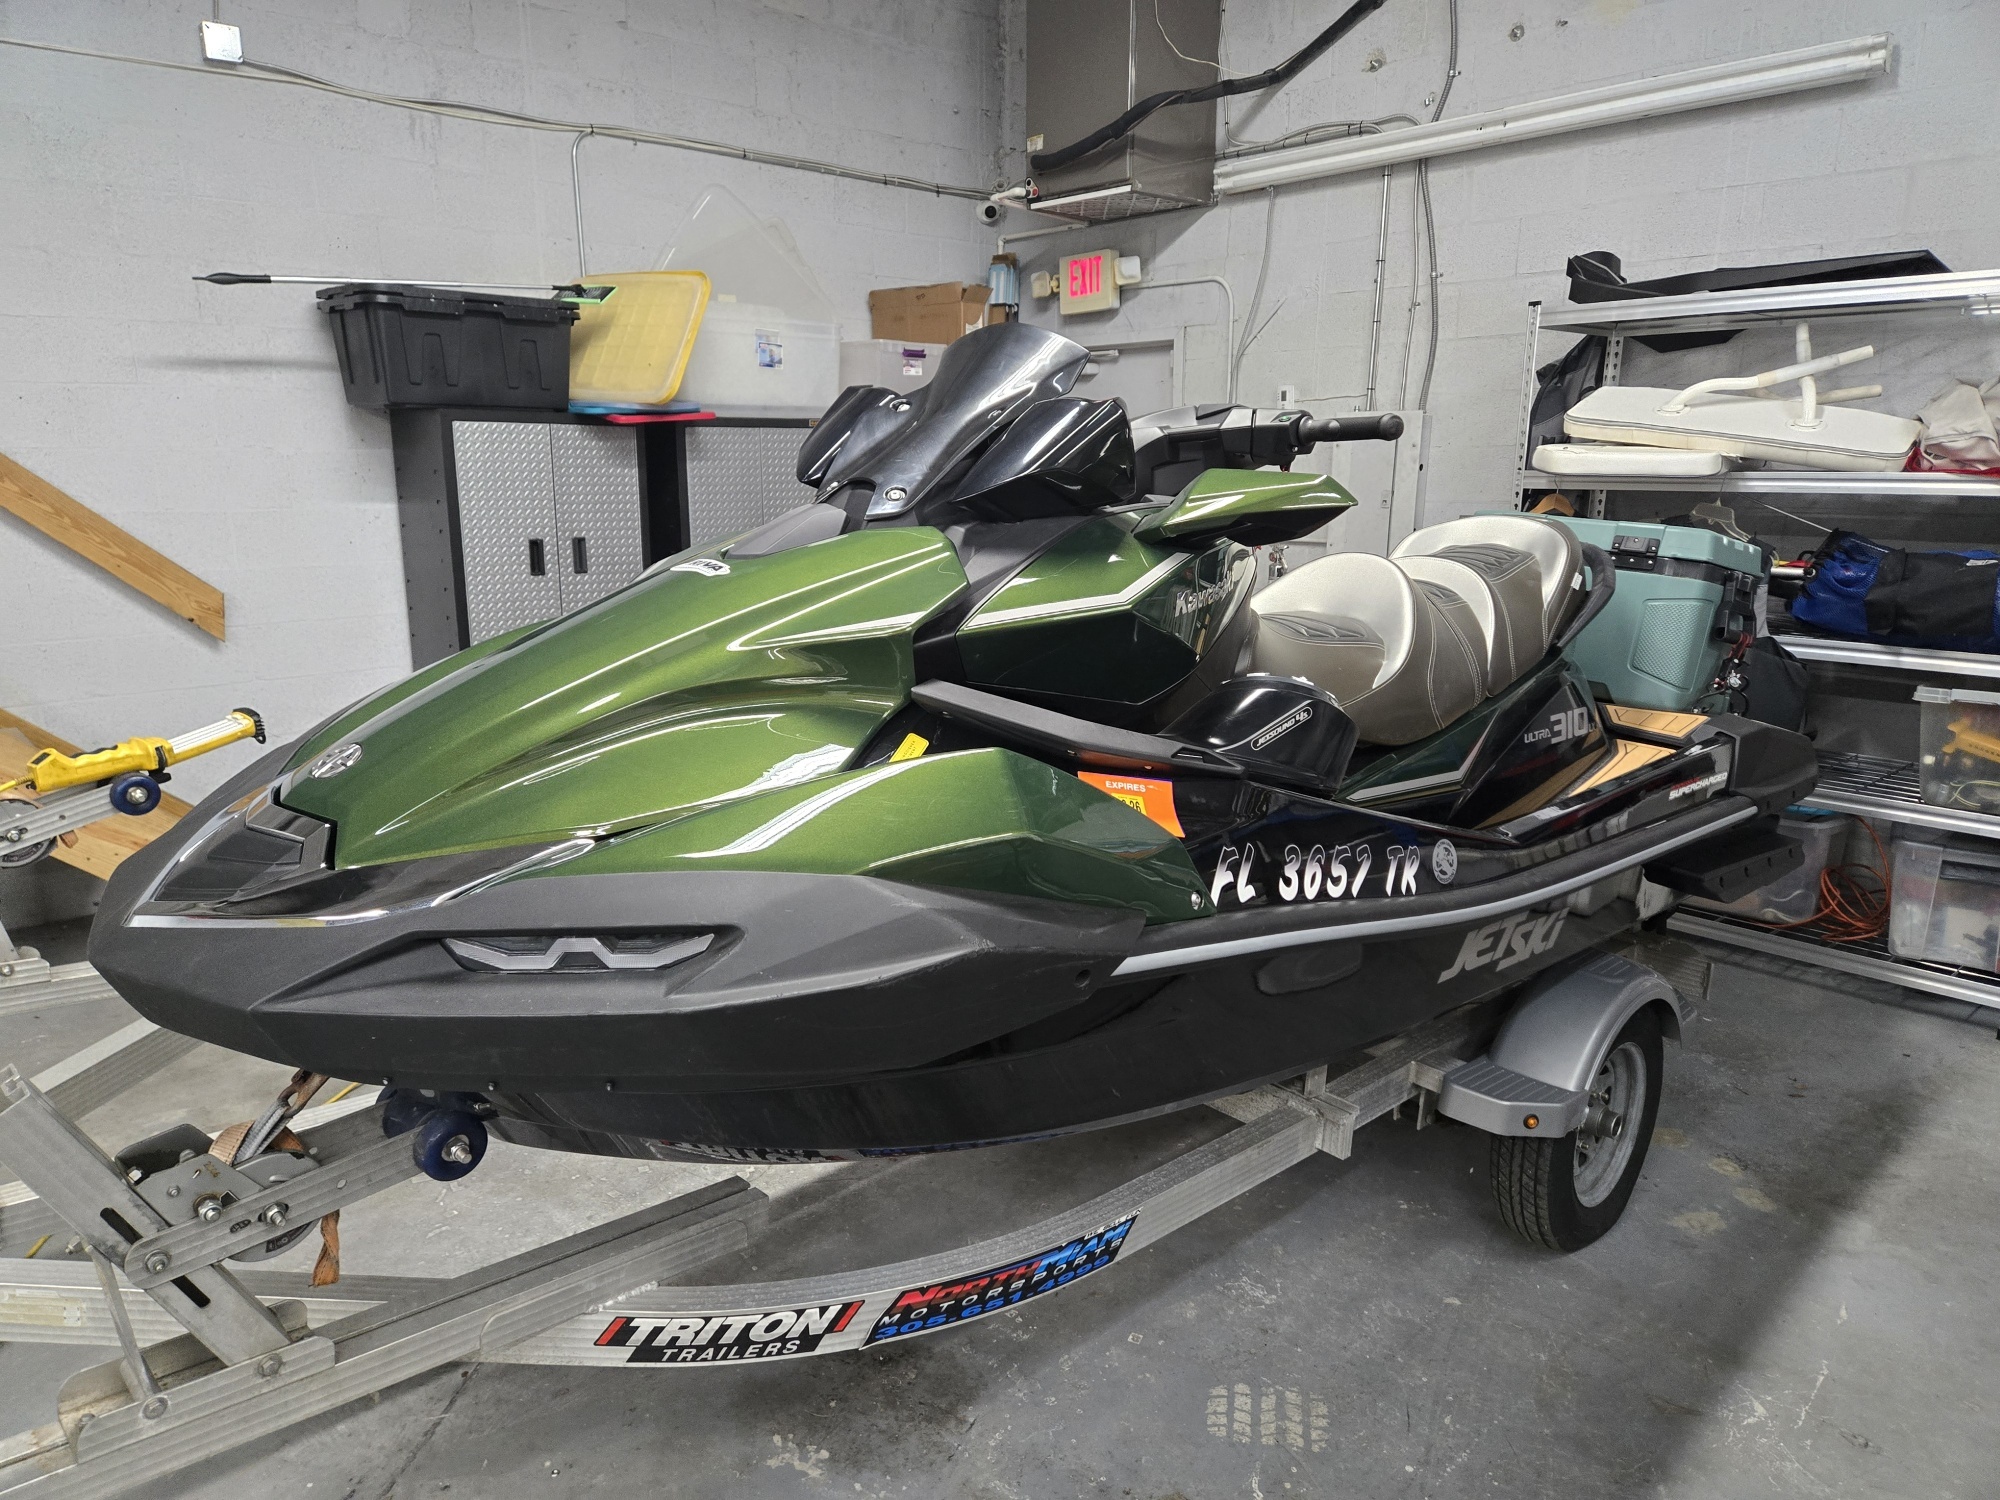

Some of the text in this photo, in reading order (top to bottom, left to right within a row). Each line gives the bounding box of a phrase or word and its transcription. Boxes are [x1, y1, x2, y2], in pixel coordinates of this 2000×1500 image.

[1069, 255, 1102, 297] EXIT
[1256, 718, 1296, 747] JETSOUND
[1524, 728, 1552, 743] ULTRA
[1550, 706, 1589, 744] 310
[1105, 780, 1147, 793] EXPIRES
[1668, 771, 1728, 801] SUPERCHARGED
[1210, 842, 1420, 907] FL 3657 TR
[878, 1238, 1124, 1327] MOTORSPORTS
[625, 1304, 843, 1347] TRITON
[660, 1339, 801, 1362] TRAILERS
